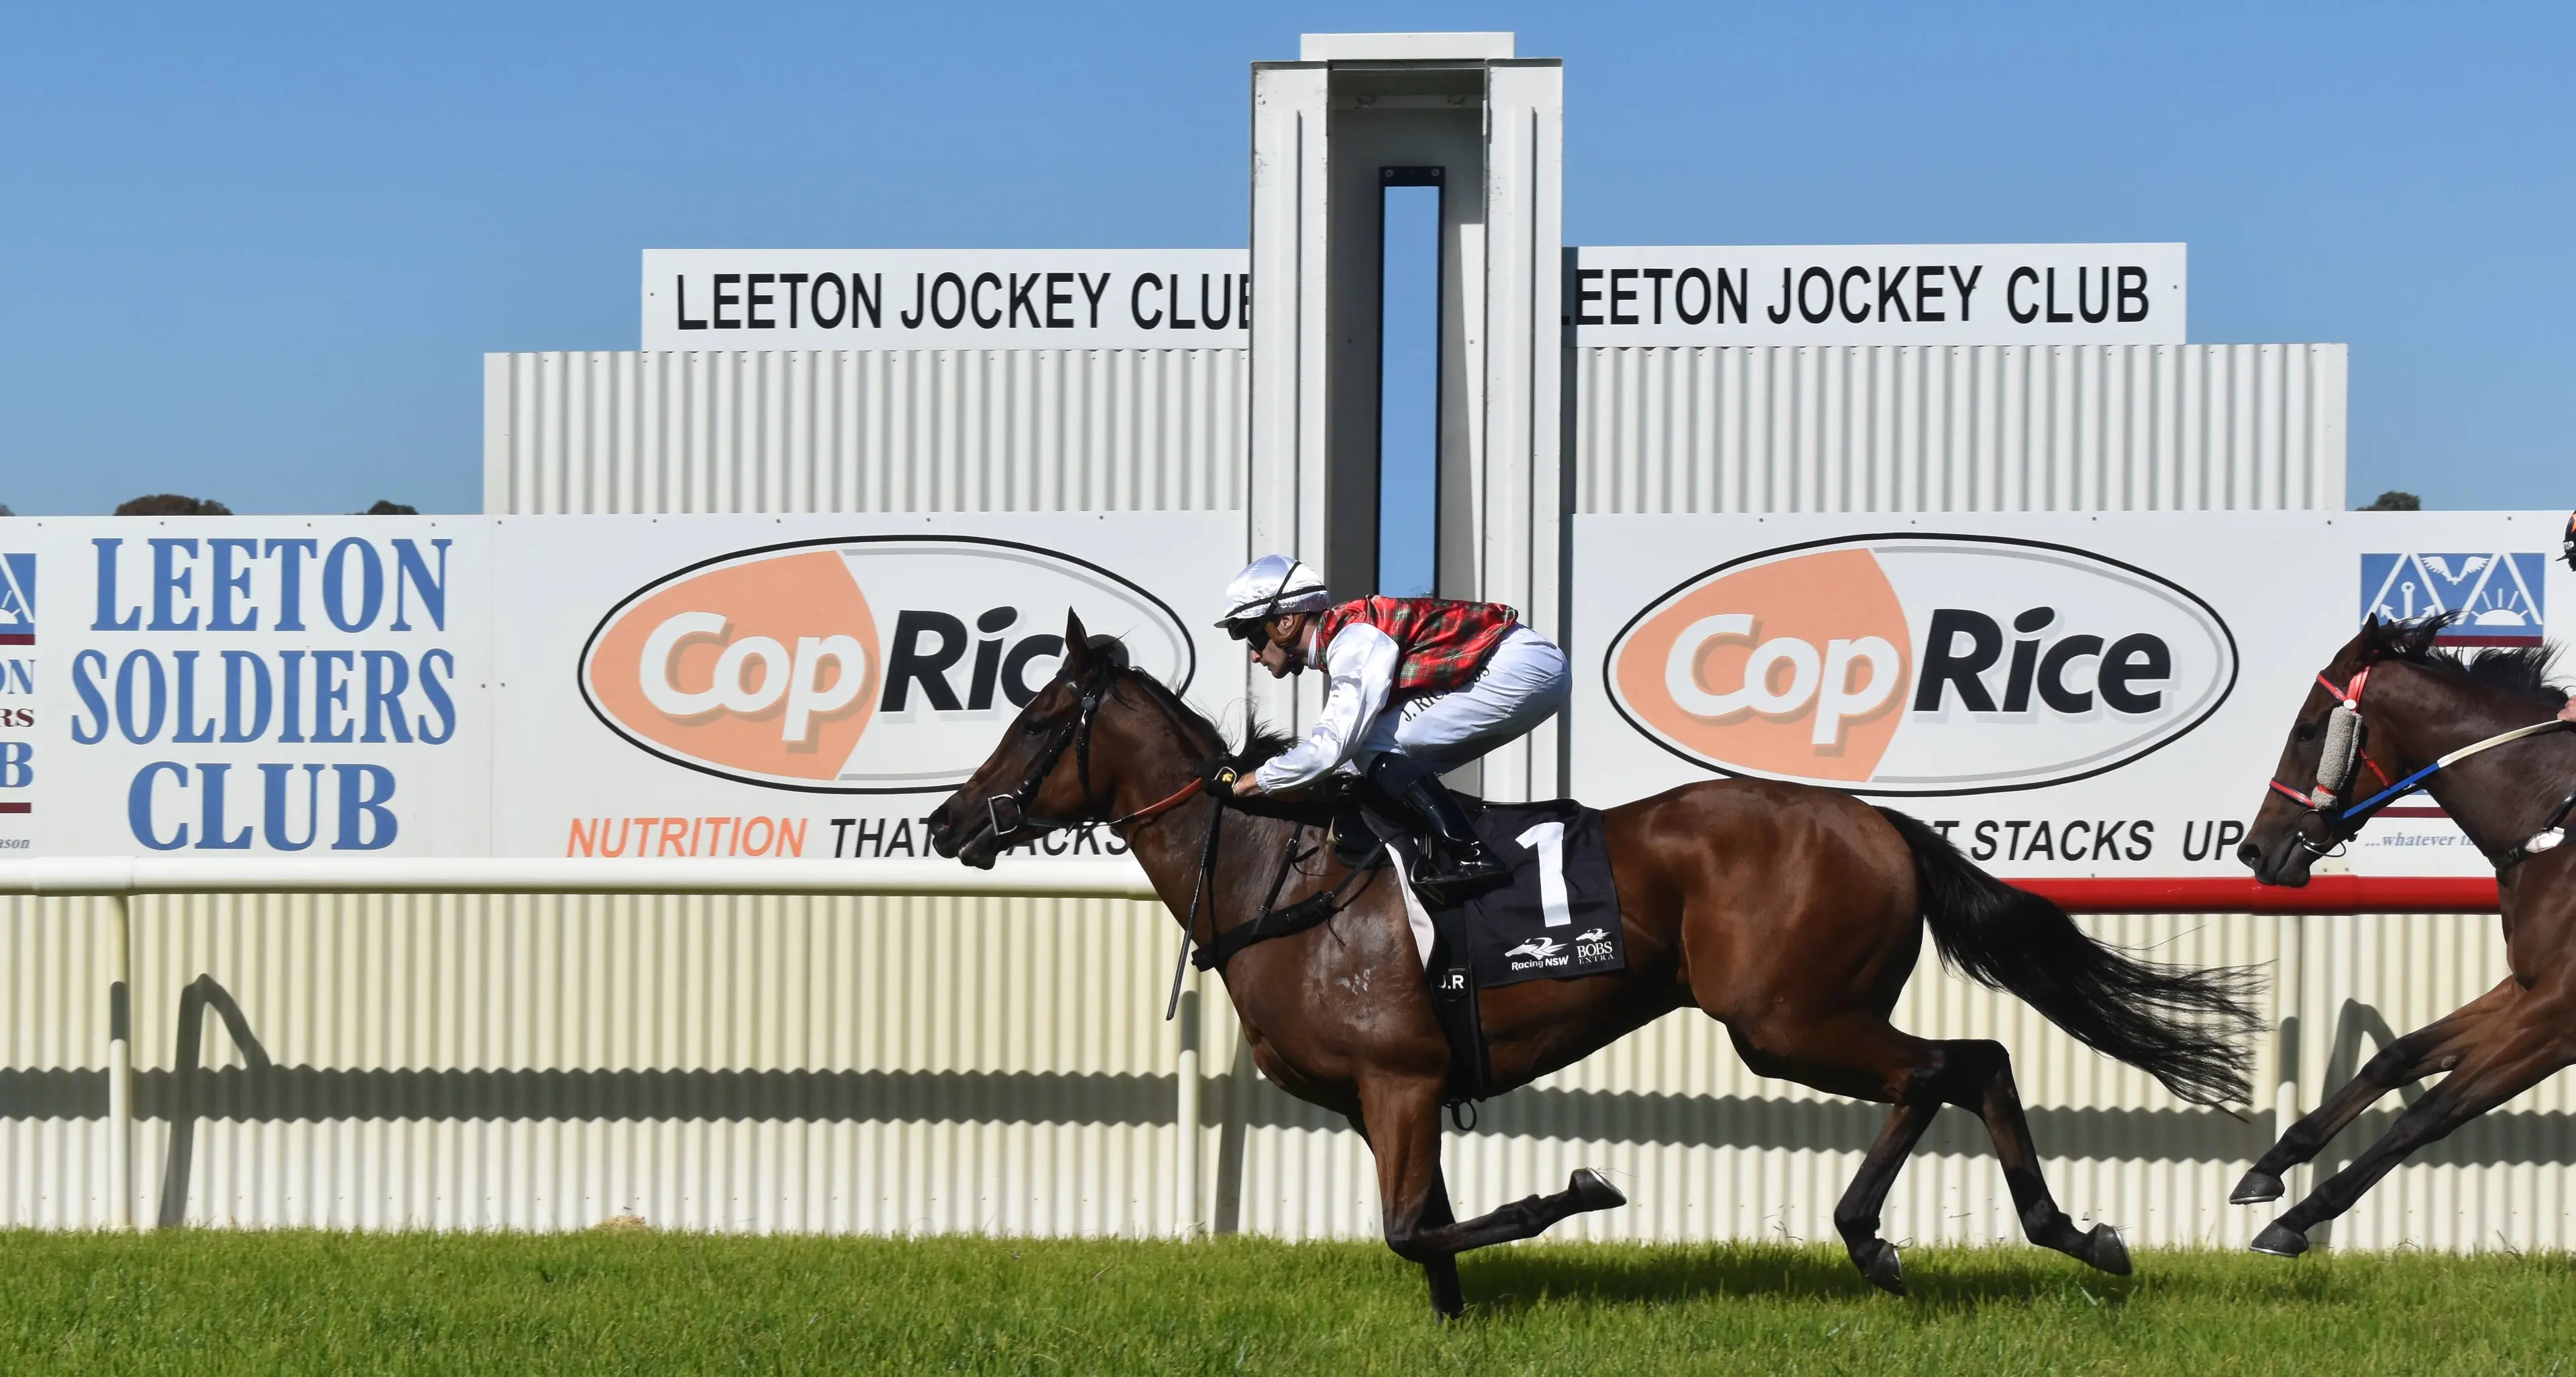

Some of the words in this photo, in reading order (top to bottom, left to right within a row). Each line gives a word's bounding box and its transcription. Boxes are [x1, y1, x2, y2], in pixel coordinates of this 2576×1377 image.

[677, 272, 881, 330] LEETON
[901, 272, 1111, 329] JOCKEY
[1562, 268, 1746, 326] EETON
[1768, 266, 1982, 324] JOCKEY
[2008, 266, 2149, 323] CLUB
[91, 537, 452, 632] LEETON
[72, 649, 455, 745] SOLDIERS
[128, 761, 398, 851] CLUB
[567, 816, 808, 857] NUTRITION
[1971, 820, 2154, 861] STACKS
[2184, 821, 2244, 861] UP
[1515, 822, 1571, 928] 1
[1511, 959, 1544, 971] Racing
[1545, 955, 1569, 967] NSW
[1576, 941, 1613, 958] BOBS
[1578, 953, 1614, 965] EXTRA
